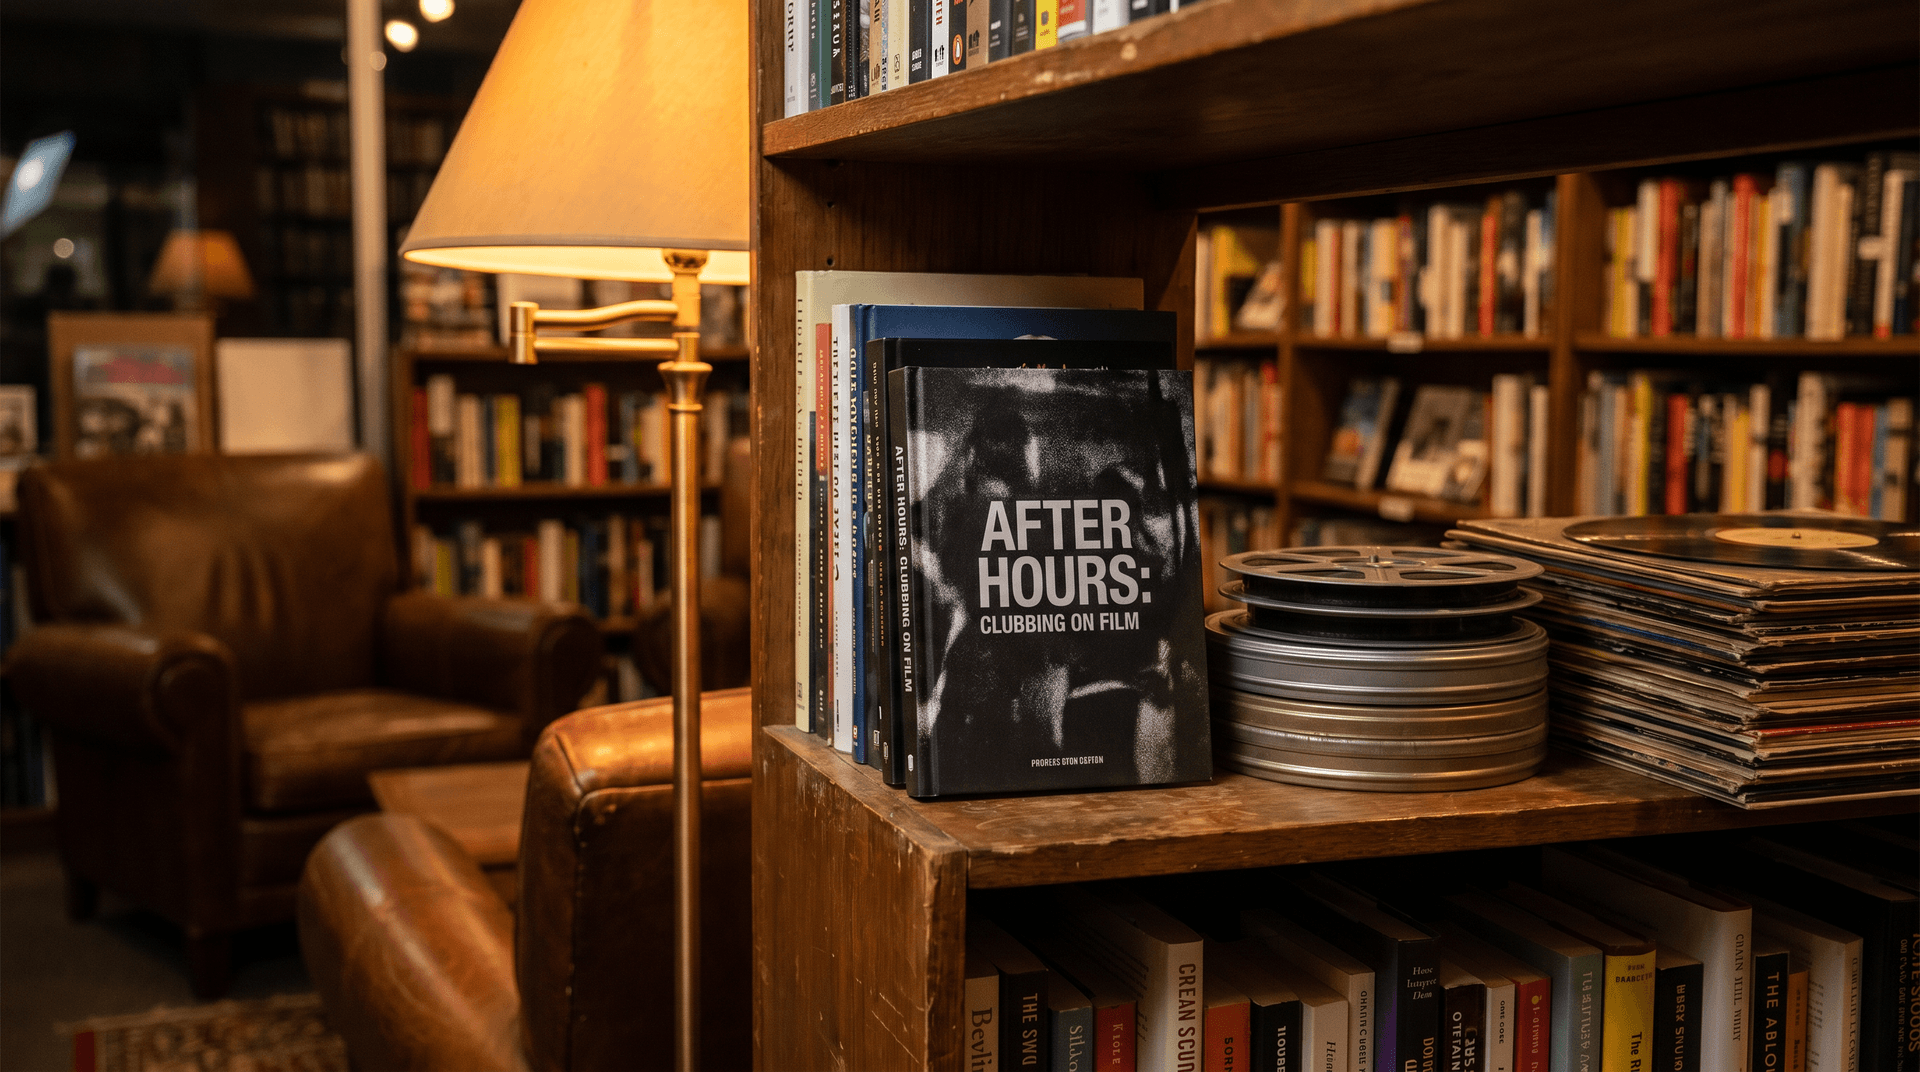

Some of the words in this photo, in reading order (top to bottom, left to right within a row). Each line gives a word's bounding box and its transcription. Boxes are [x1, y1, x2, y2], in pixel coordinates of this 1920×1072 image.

[895, 446, 904, 493] AFTER
[896, 496, 906, 551] HOURS:
[981, 499, 1133, 552] AFTER
[899, 556, 911, 628] CLUBBING
[979, 554, 1152, 608] HOURS:
[903, 631, 912, 653] ON
[980, 613, 1066, 635] CLUBBING
[1070, 612, 1095, 632] ON
[1099, 611, 1140, 631] FILM
[904, 656, 914, 693] FILM
[1021, 992, 1038, 1024] THE
[1178, 963, 1196, 1021] CREAN
[1766, 971, 1779, 1009] THE
[1630, 1031, 1642, 1056] The
[1764, 1017, 1778, 1072] ABLO
